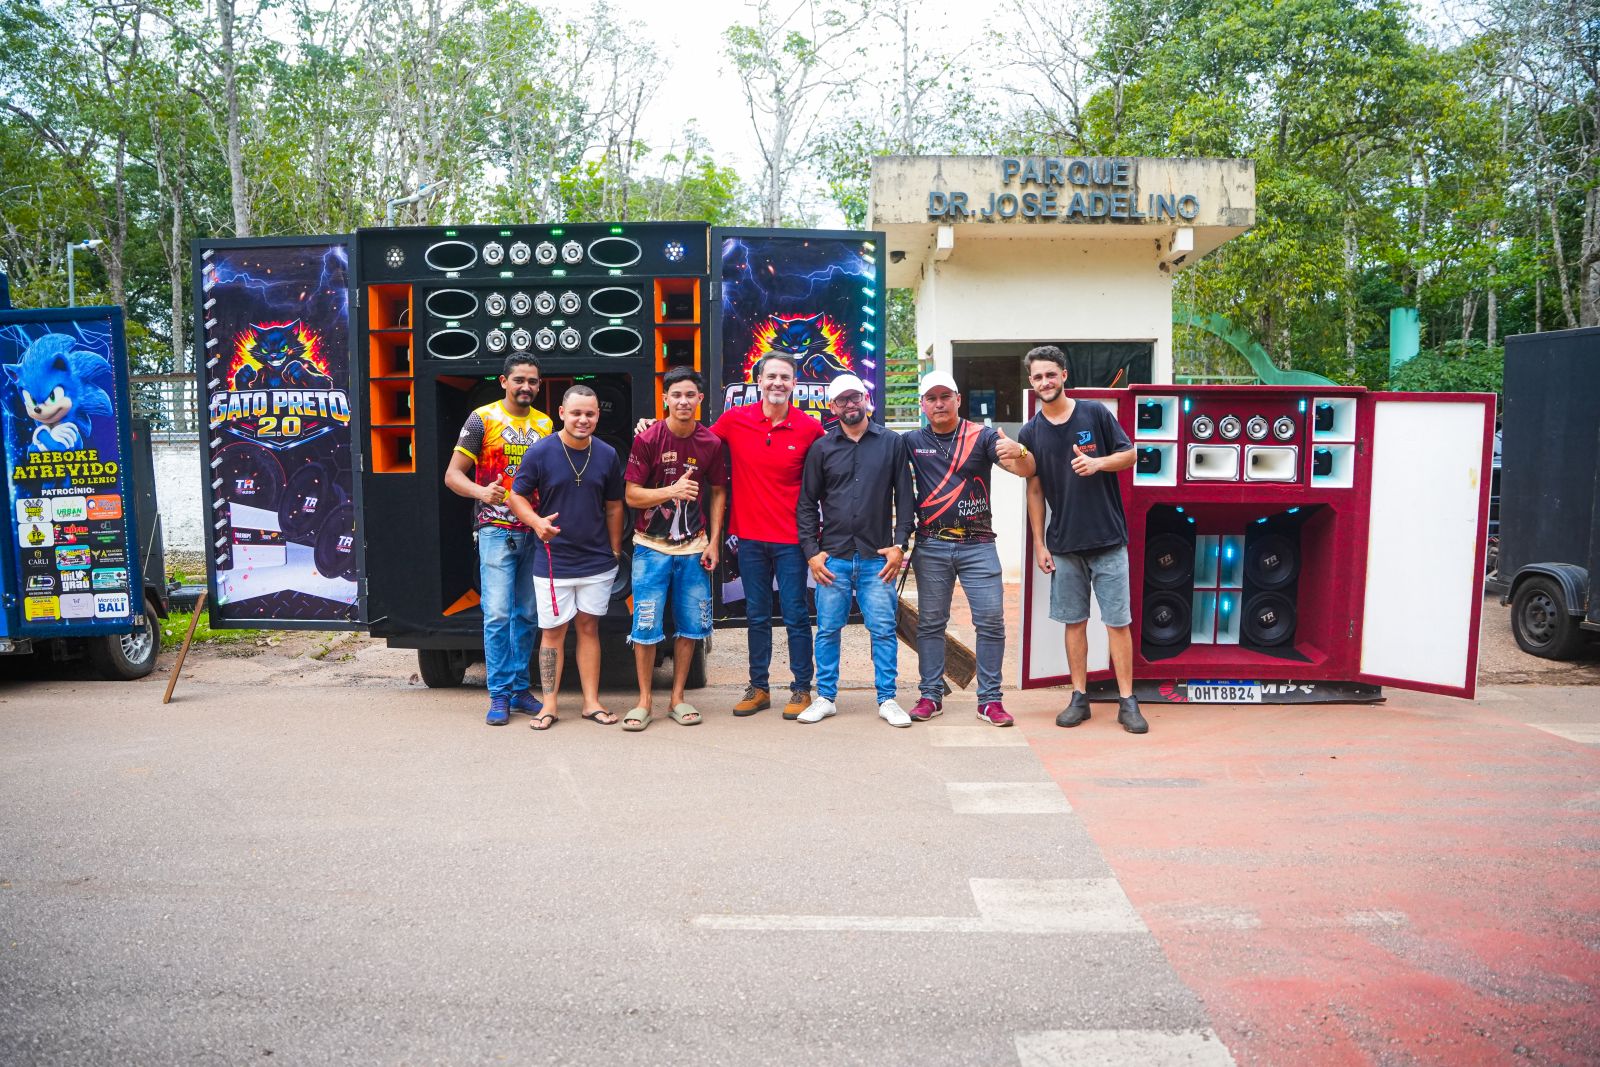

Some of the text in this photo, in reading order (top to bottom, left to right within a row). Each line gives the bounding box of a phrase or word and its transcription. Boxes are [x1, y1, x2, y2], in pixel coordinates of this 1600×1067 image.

[1002, 159, 1130, 186] PARQUE
[928, 191, 976, 216] DR.
[1066, 191, 1201, 219] ADELINO
[210, 391, 351, 423] GATO PRETO
[257, 416, 302, 438] 2.0
[29, 449, 98, 464] REBOKE
[13, 461, 118, 480] ATREVIDO
[87, 476, 117, 484] LENIO
[41, 486, 96, 496] PATROCÍNIO:
[304, 496, 318, 507] TR
[957, 497, 987, 509] CHAMA
[56, 508, 82, 516] URBAN
[338, 535, 354, 547] TR
[28, 558, 49, 566] CARLI
[1263, 554, 1278, 566] TR
[98, 602, 125, 613] BALI
[1260, 611, 1275, 623] TR
